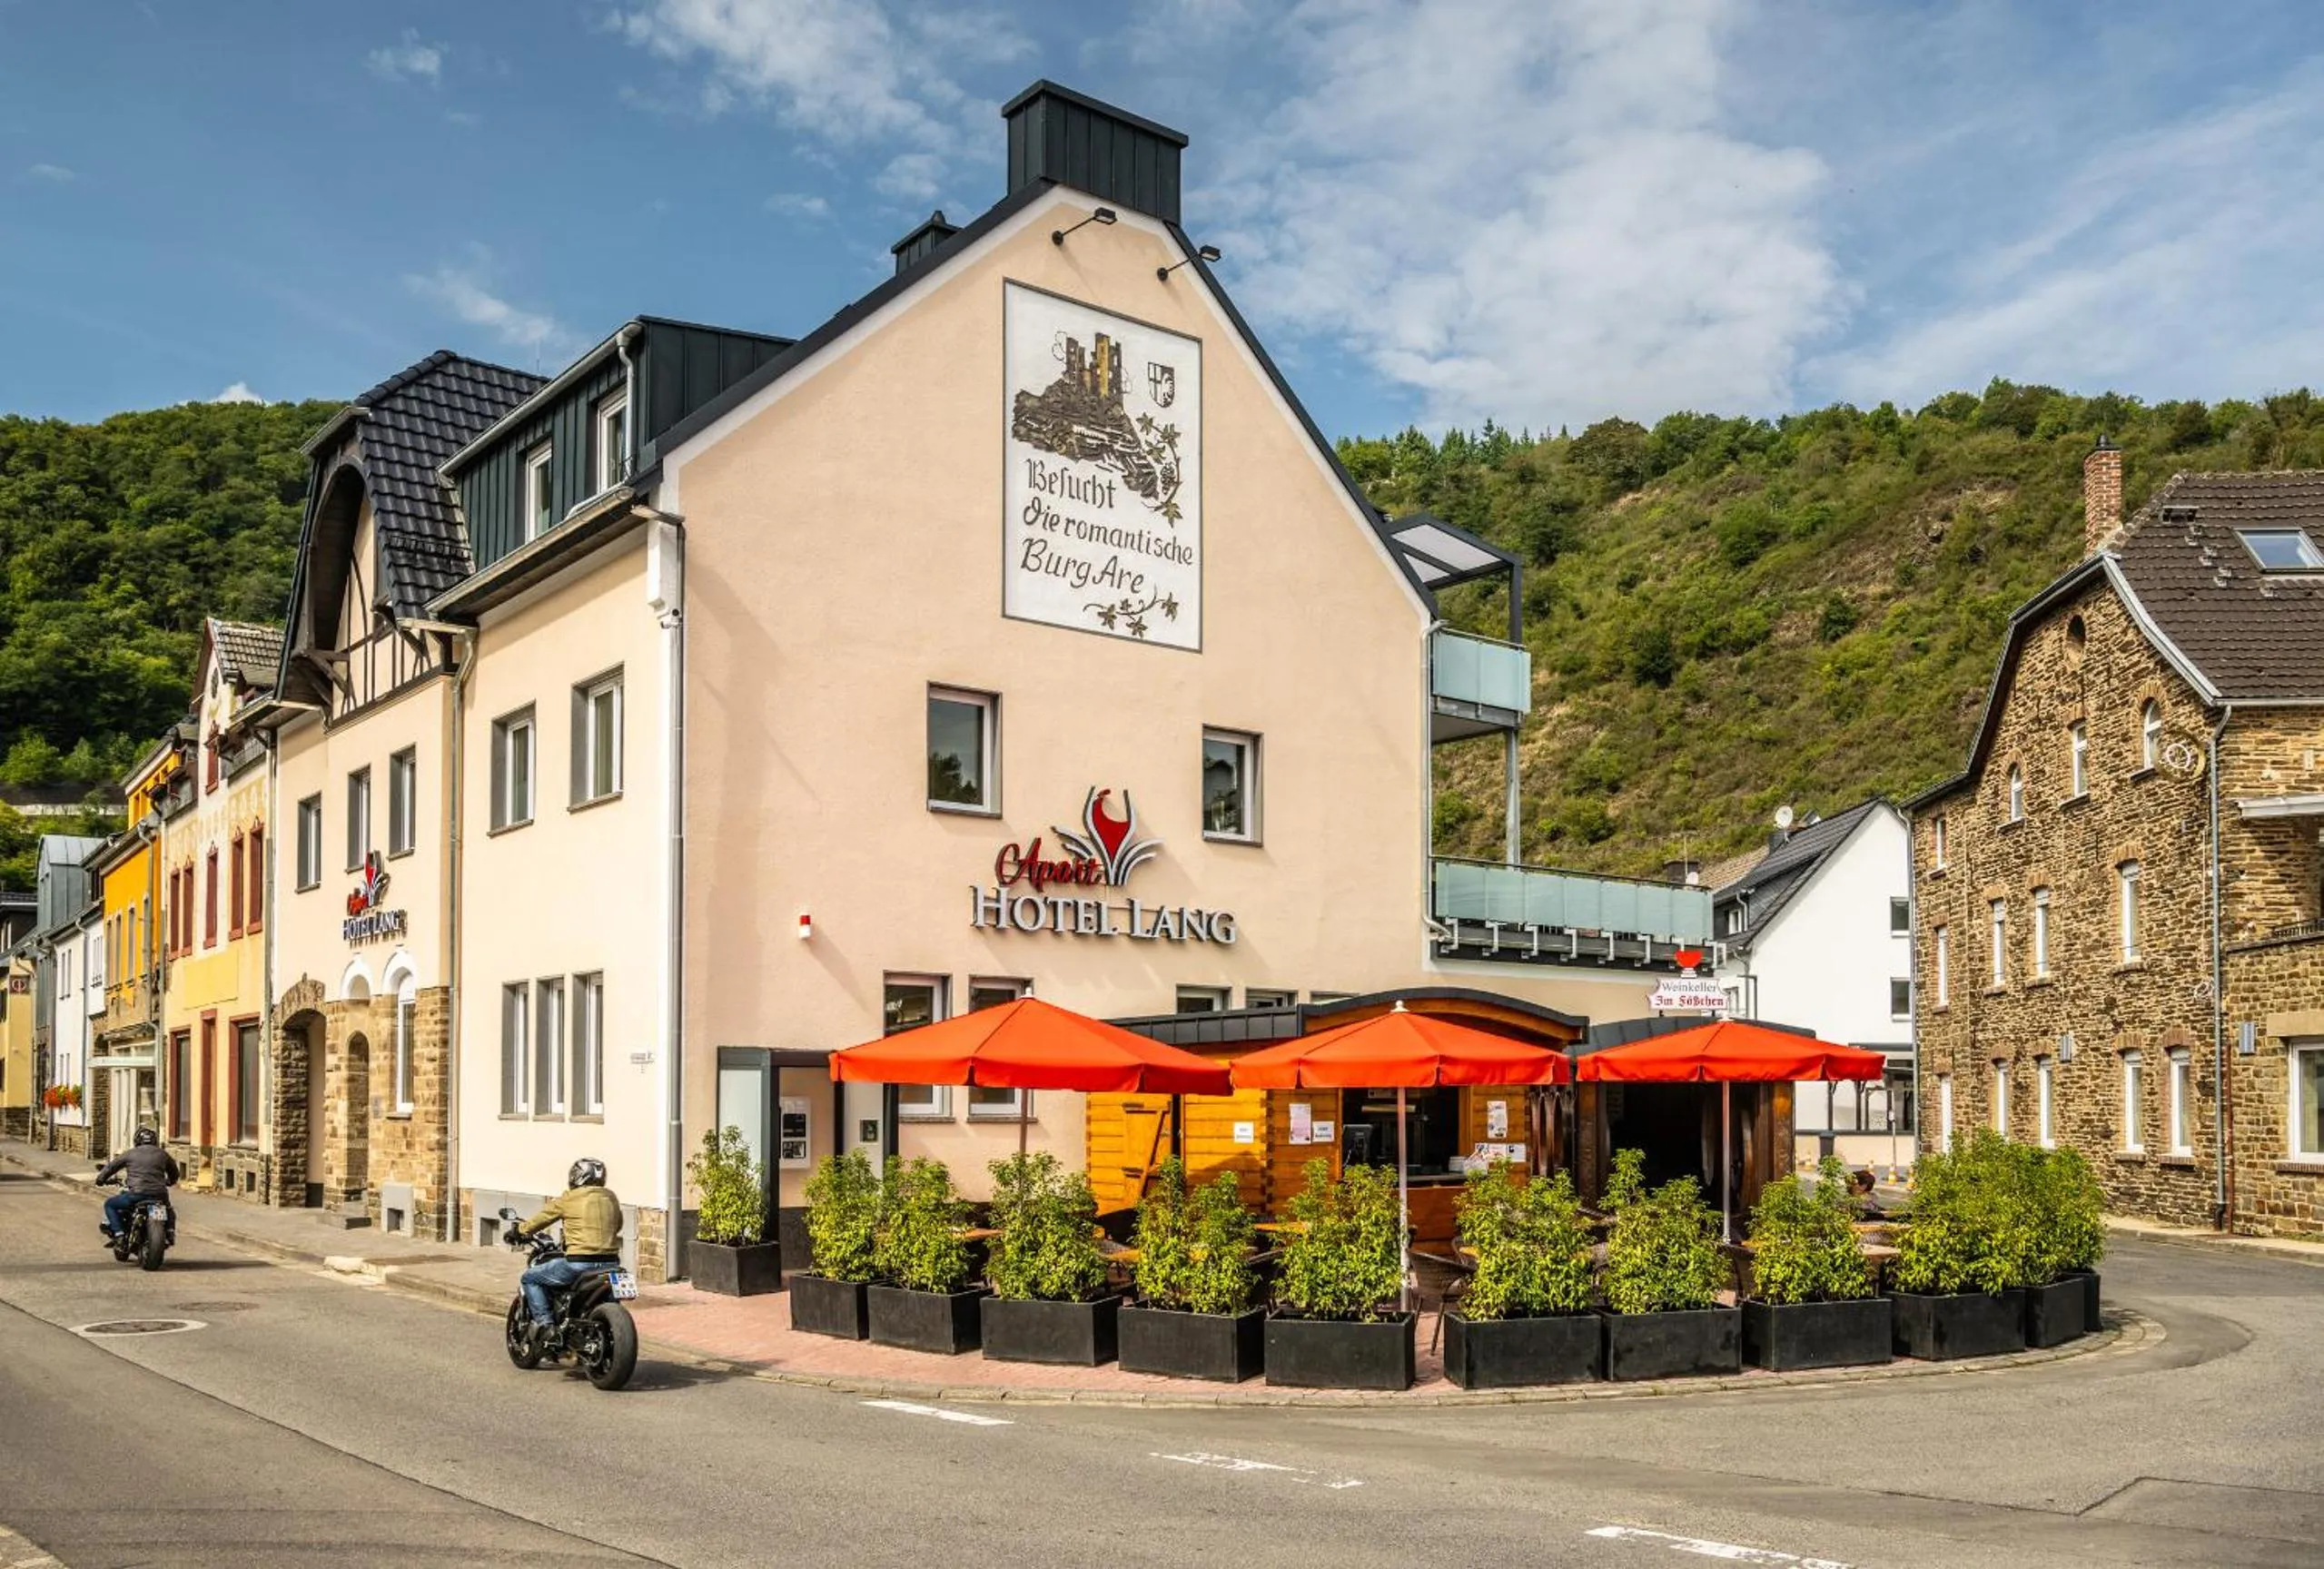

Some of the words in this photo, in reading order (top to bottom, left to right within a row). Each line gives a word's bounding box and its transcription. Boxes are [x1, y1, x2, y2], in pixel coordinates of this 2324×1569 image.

[1020, 538, 1091, 589] Burg
[1092, 555, 1144, 594] Are
[1063, 516, 1193, 566] romantische
[994, 836, 1104, 893] Apart
[969, 884, 1119, 935] HOTEL
[1129, 897, 1237, 944] LANG
[1662, 982, 1716, 992] Weinkeller
